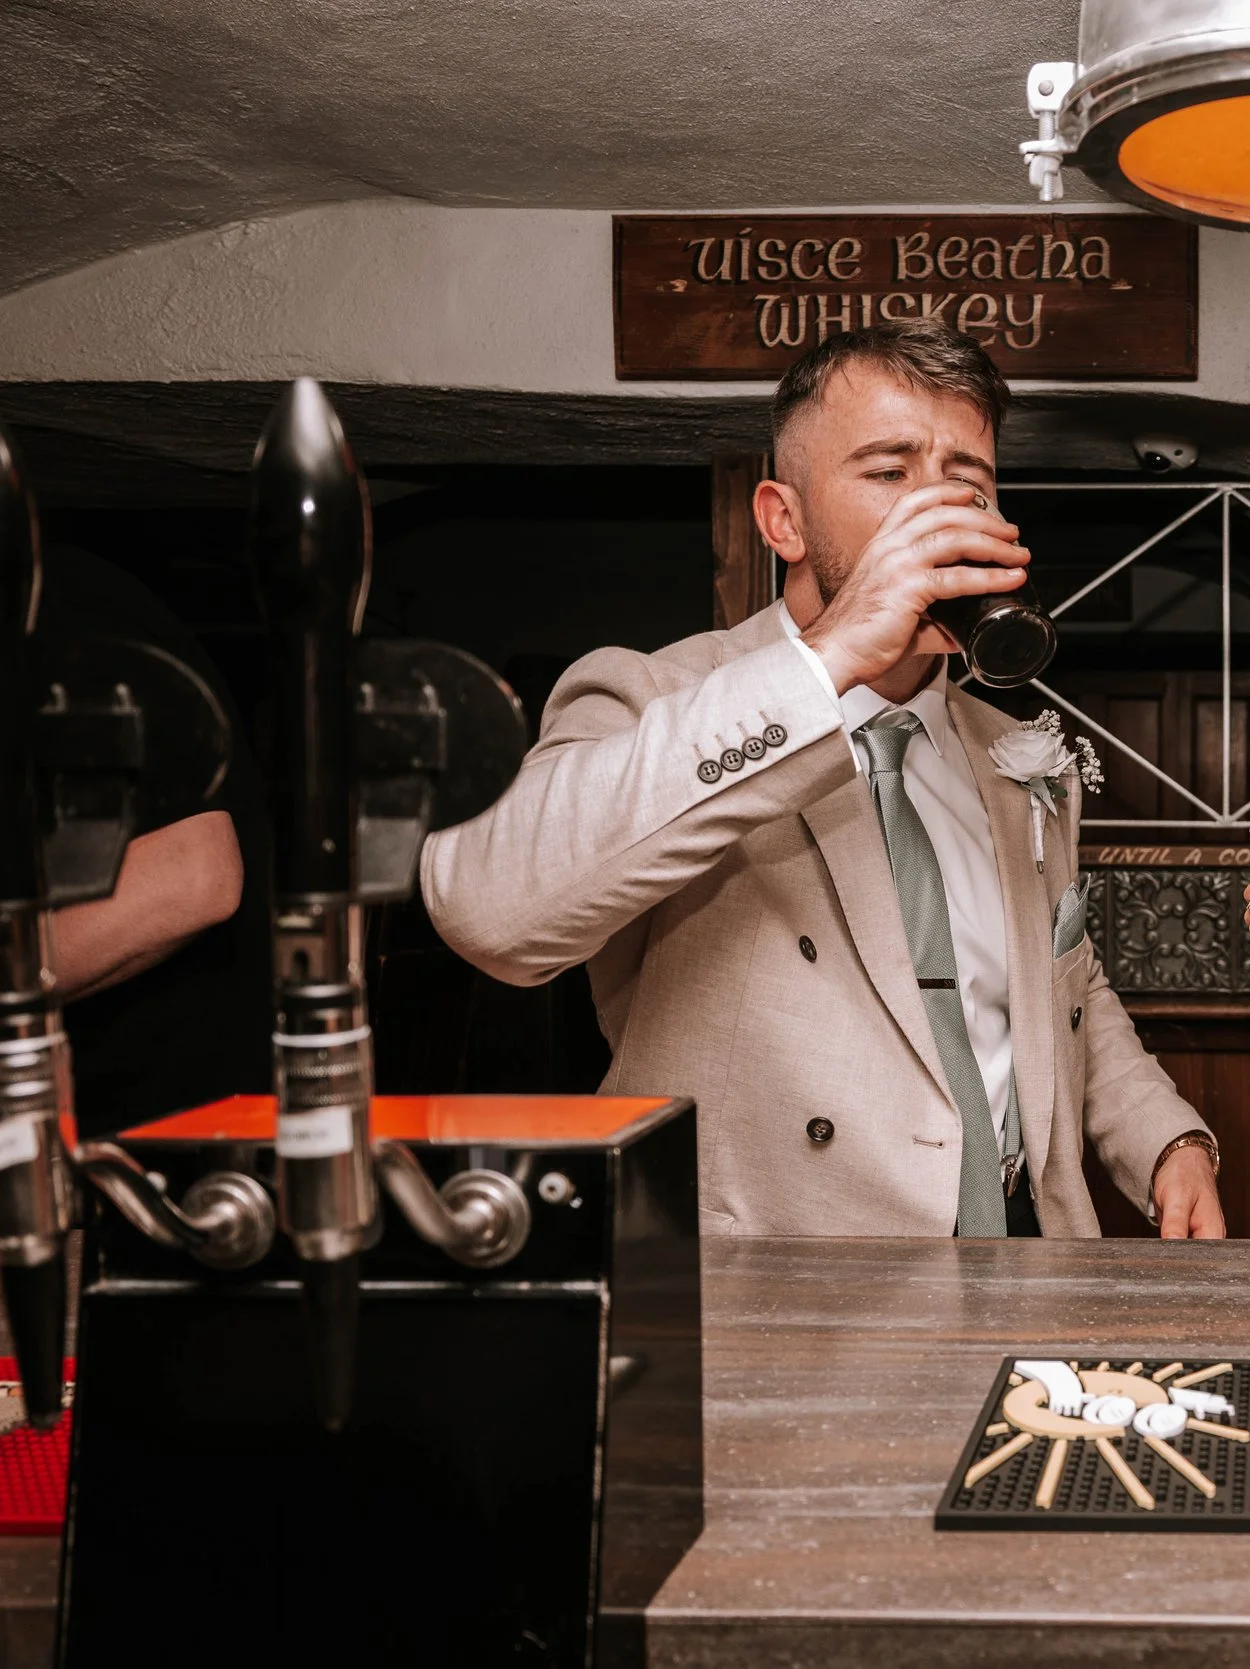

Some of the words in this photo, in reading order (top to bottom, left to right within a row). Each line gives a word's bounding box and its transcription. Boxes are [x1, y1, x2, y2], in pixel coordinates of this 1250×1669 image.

[895, 231, 1113, 281] Beatha
[1098, 847, 1172, 865] UNTIL
[1184, 848, 1203, 865] A
